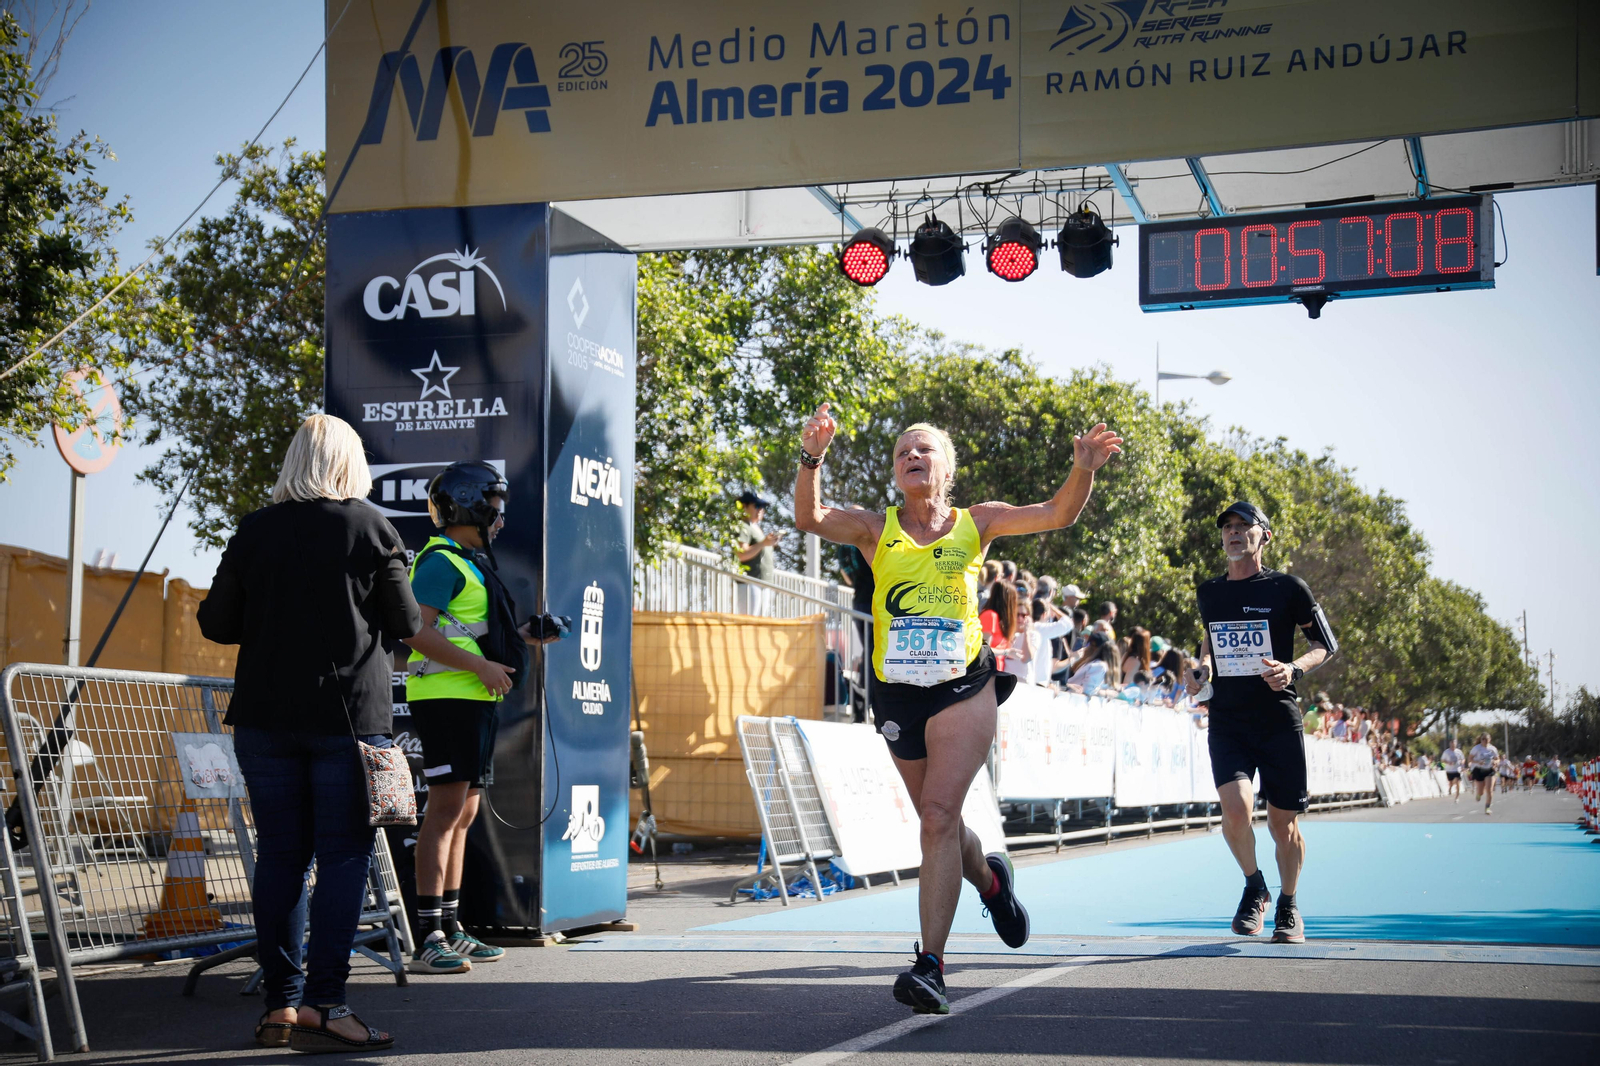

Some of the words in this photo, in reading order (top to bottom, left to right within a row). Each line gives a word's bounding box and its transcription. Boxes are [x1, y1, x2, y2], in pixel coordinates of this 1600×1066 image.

[1140, 13, 1224, 33] SERIES
[648, 26, 785, 72] Medio
[810, 7, 1010, 58] Maratón
[1133, 33, 1186, 49] RUTA
[1190, 23, 1273, 43] RUNNING
[559, 41, 608, 78] 25
[1046, 59, 1171, 95] RAMÓN
[1189, 52, 1272, 83] RUIZ
[1286, 29, 1469, 73] ANDÚJAR
[558, 77, 608, 92] EDICIÓN
[645, 66, 849, 127] Almería
[863, 53, 1012, 111] 2024
[363, 270, 476, 321] CASI
[567, 331, 624, 370] COOPERACIÓN
[567, 349, 588, 370] 2005
[362, 397, 508, 422] ESTRELLA
[395, 422, 415, 432] DE
[415, 419, 475, 430] LEVANTE
[896, 629, 957, 652] 5616
[1217, 631, 1264, 648] 5840
[572, 679, 612, 702] ALMERÍA
